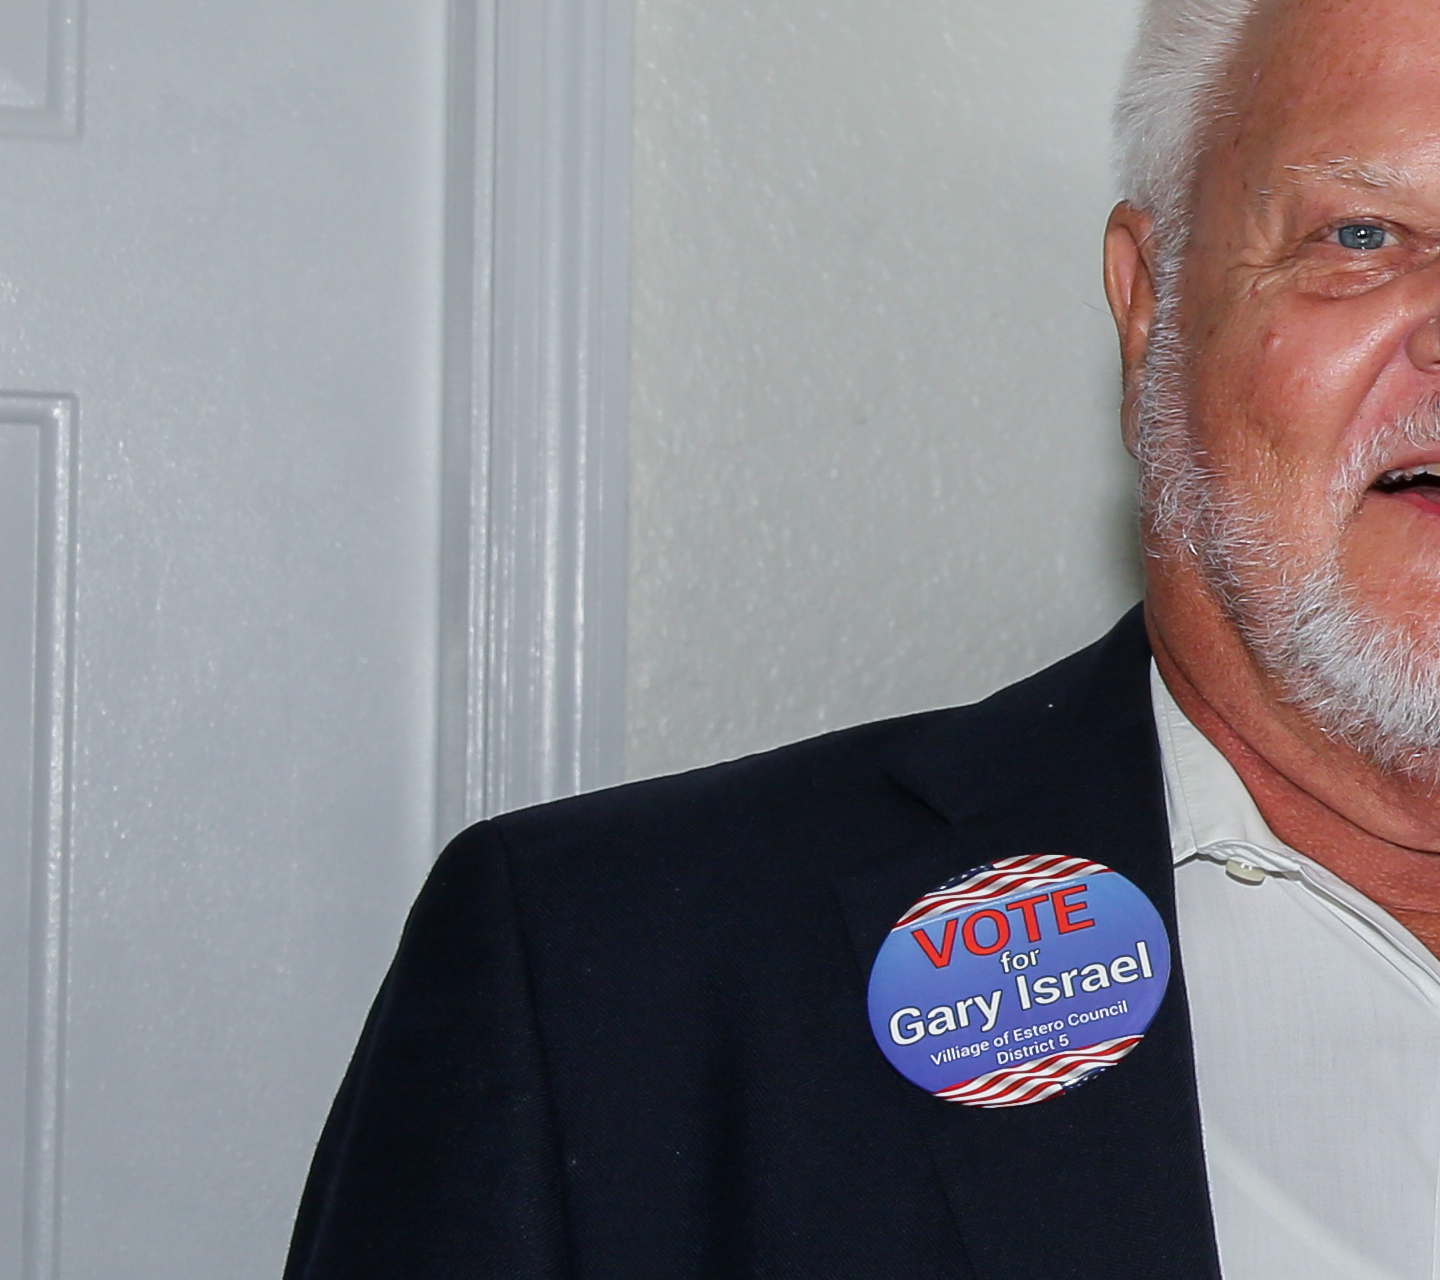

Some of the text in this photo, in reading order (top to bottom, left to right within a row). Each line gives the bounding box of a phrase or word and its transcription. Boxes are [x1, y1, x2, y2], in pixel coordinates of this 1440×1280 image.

[911, 883, 1096, 969] VOTE
[1000, 949, 1041, 973] for
[888, 940, 1154, 1046] Gary Israel
[993, 1031, 1010, 1048] of
[1013, 1020, 1065, 1042] Estero
[1067, 1000, 1129, 1027] Council
[996, 1033, 1070, 1066] District 5
